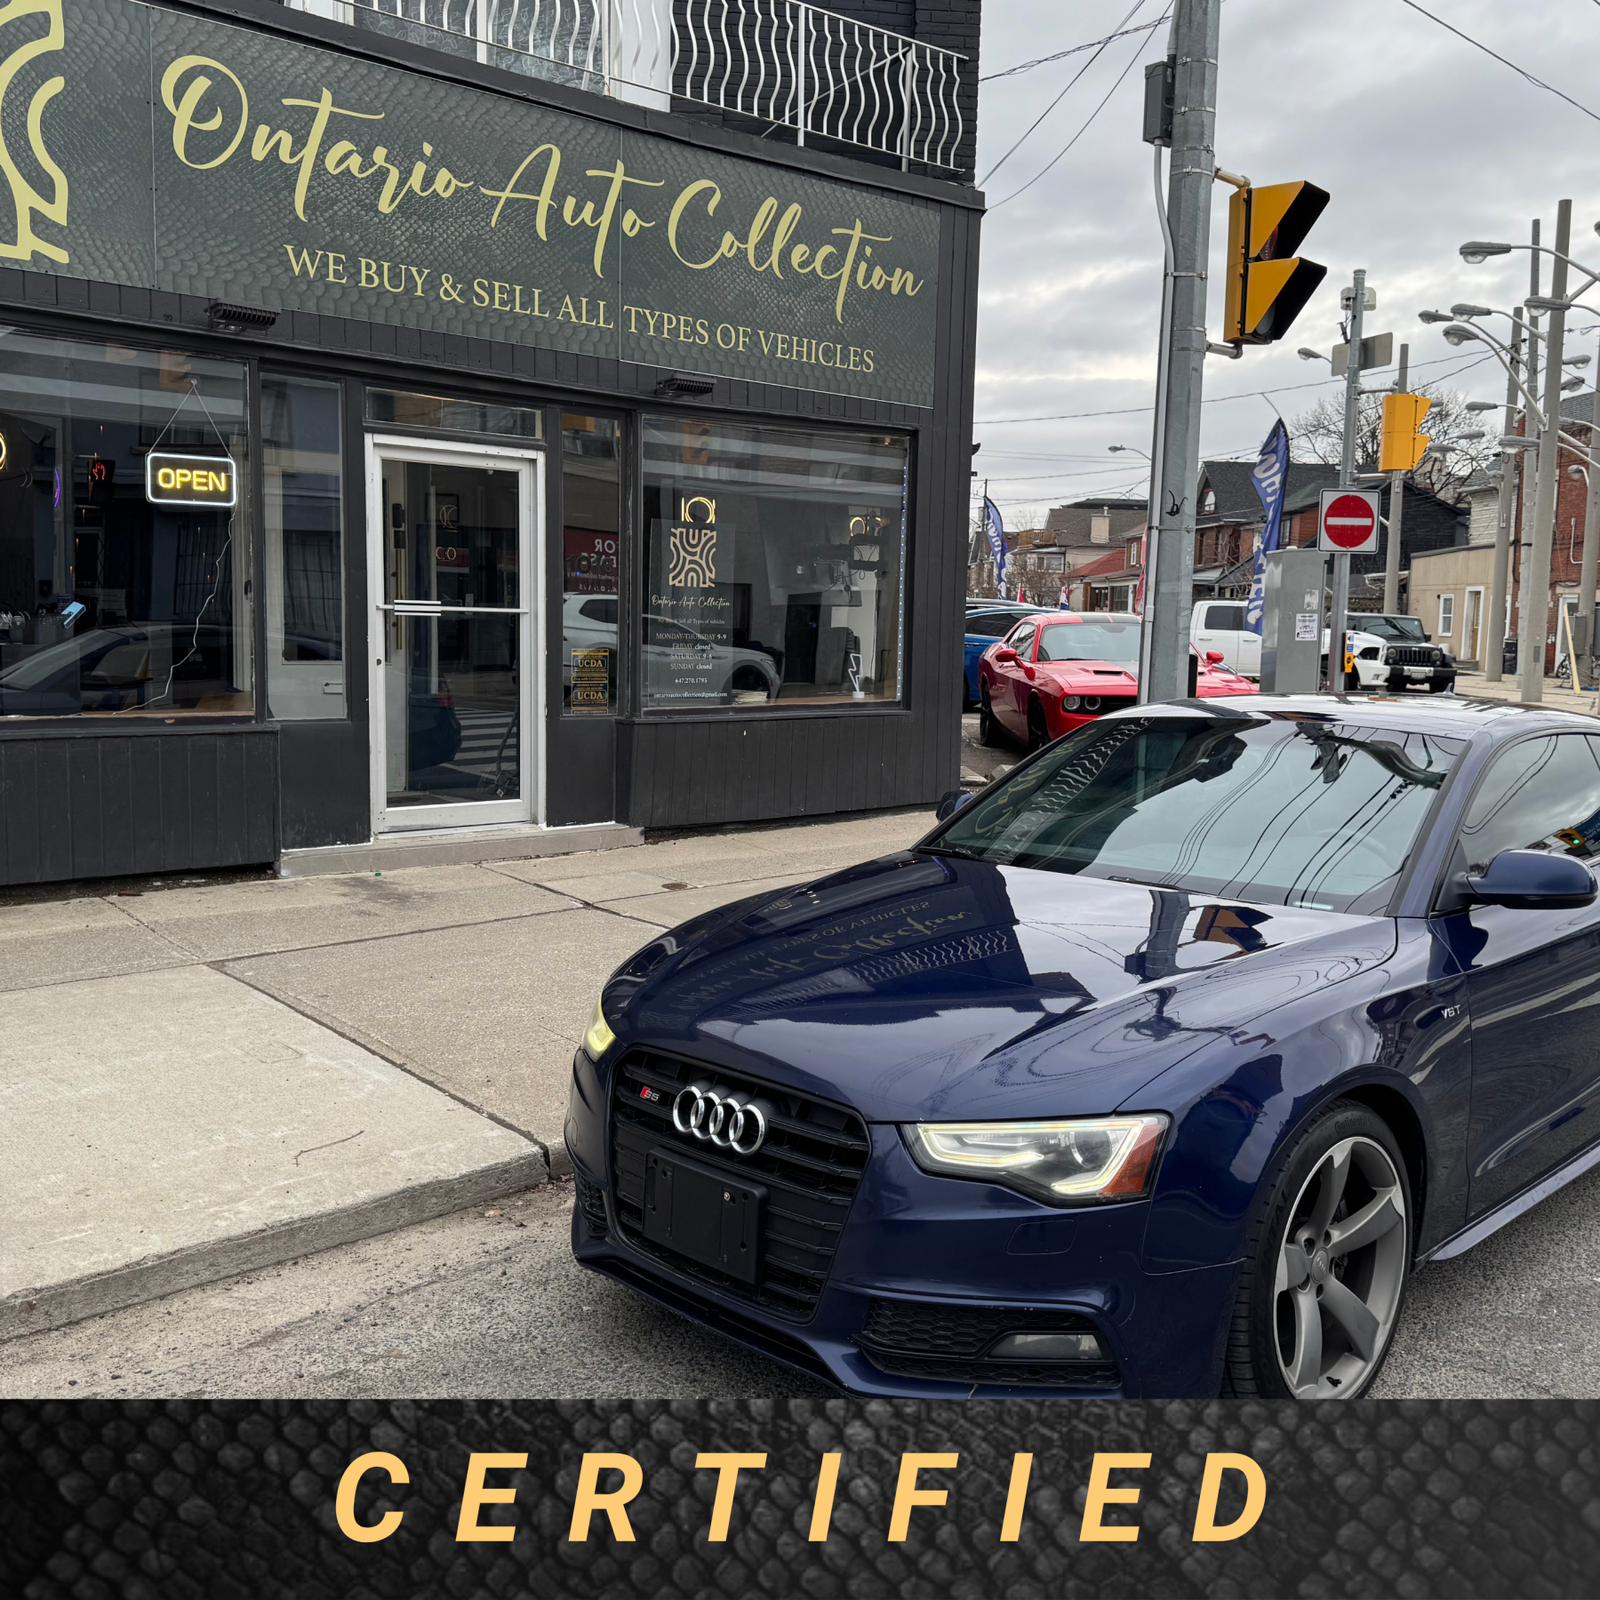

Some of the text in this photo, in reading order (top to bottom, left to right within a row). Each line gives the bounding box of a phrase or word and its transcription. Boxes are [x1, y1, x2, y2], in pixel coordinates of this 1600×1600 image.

[161, 54, 924, 324] Ontario Auto Collection
[283, 244, 875, 373] WE BUY & SELL ALL TYPES OF VEHICLES
[158, 467, 227, 492] OPEN
[651, 594, 731, 610] Ontario Auto Collection
[656, 632, 716, 640] MONDAY-THURSDAY
[672, 642, 694, 650] FRIDAY
[670, 652, 702, 660] SATURDAY
[577, 659, 604, 668] UCDA
[577, 691, 604, 700] UCDA
[644, 1089, 660, 1102] S5
